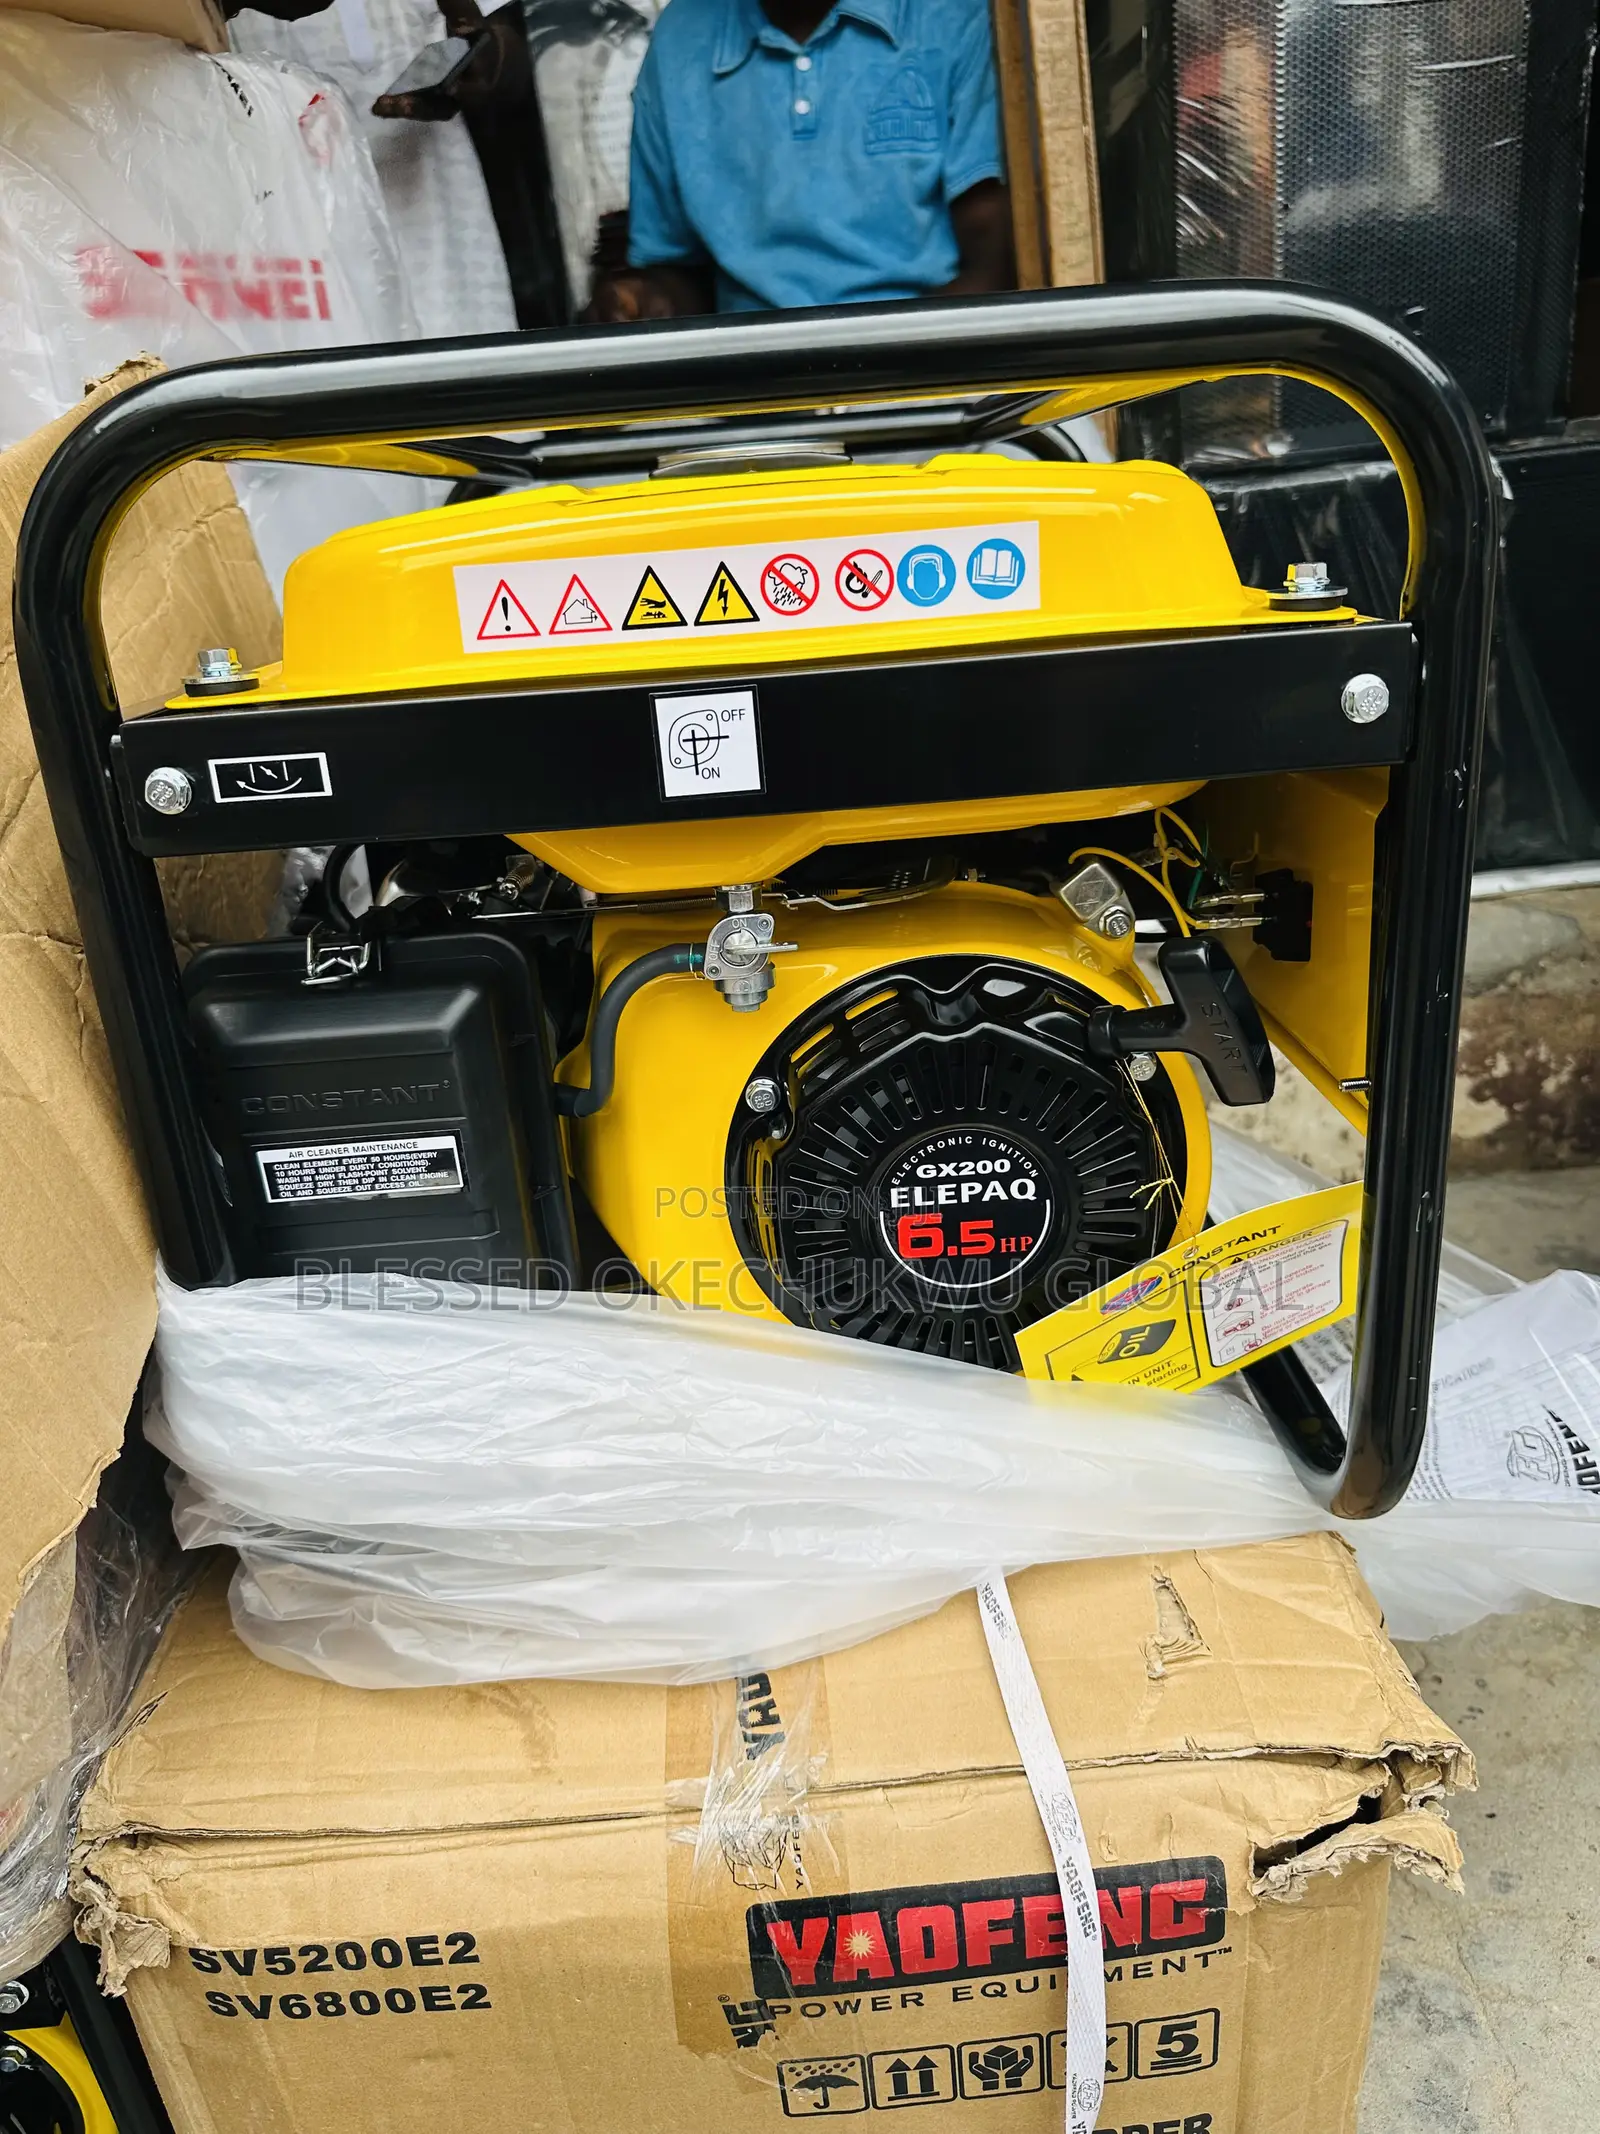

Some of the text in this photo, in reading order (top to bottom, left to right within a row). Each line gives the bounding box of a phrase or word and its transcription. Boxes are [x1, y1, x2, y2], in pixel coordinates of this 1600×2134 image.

[721, 708, 746, 722] OFF
[701, 767, 720, 779] ON
[731, 918, 748, 928] ON
[1201, 1002, 1248, 1073] START
[273, 1162, 300, 1171] CLEAN
[303, 1159, 339, 1168] ELEMENT
[342, 1156, 368, 1165] EVERY
[289, 1141, 419, 1159] AIR CLEANER MAINTENANCE
[891, 1136, 1040, 1186] ELECTRONIC IGNITION
[276, 1176, 300, 1185] WASH
[315, 1173, 336, 1181] HIGH
[338, 1169, 389, 1180] FLASH-POINT
[392, 1166, 428, 1175] SOLVENT.
[278, 1182, 315, 1192] SQUEEZE
[337, 1178, 359, 1187] THEN
[391, 1174, 417, 1182] CLEAN
[420, 1171, 449, 1180] ENGINE
[288, 1168, 316, 1176] HOURS
[319, 1165, 347, 1174] UNDER
[349, 1163, 375, 1171] DUSTY
[916, 1158, 1011, 1179] GX200
[296, 1189, 314, 1197] AND
[316, 1186, 353, 1196] SQUEEZE
[355, 1184, 372, 1192] OUT
[375, 1181, 406, 1190] EXCESS
[890, 1178, 1037, 1208] ELEPAQ
[897, 1213, 1034, 1259] 6.5 HP
[1246, 1230, 1313, 1260] DANGER
[1168, 1224, 1282, 1279] CONSTANT
[1119, 1326, 1150, 1358] OIL
[766, 1878, 1207, 1985] YAOFENG
[188, 1931, 480, 1976] SV5200E2
[204, 1983, 492, 2020] SV6800E2
[769, 1990, 925, 2020] POWER
[1155, 2019, 1199, 2059] 5
